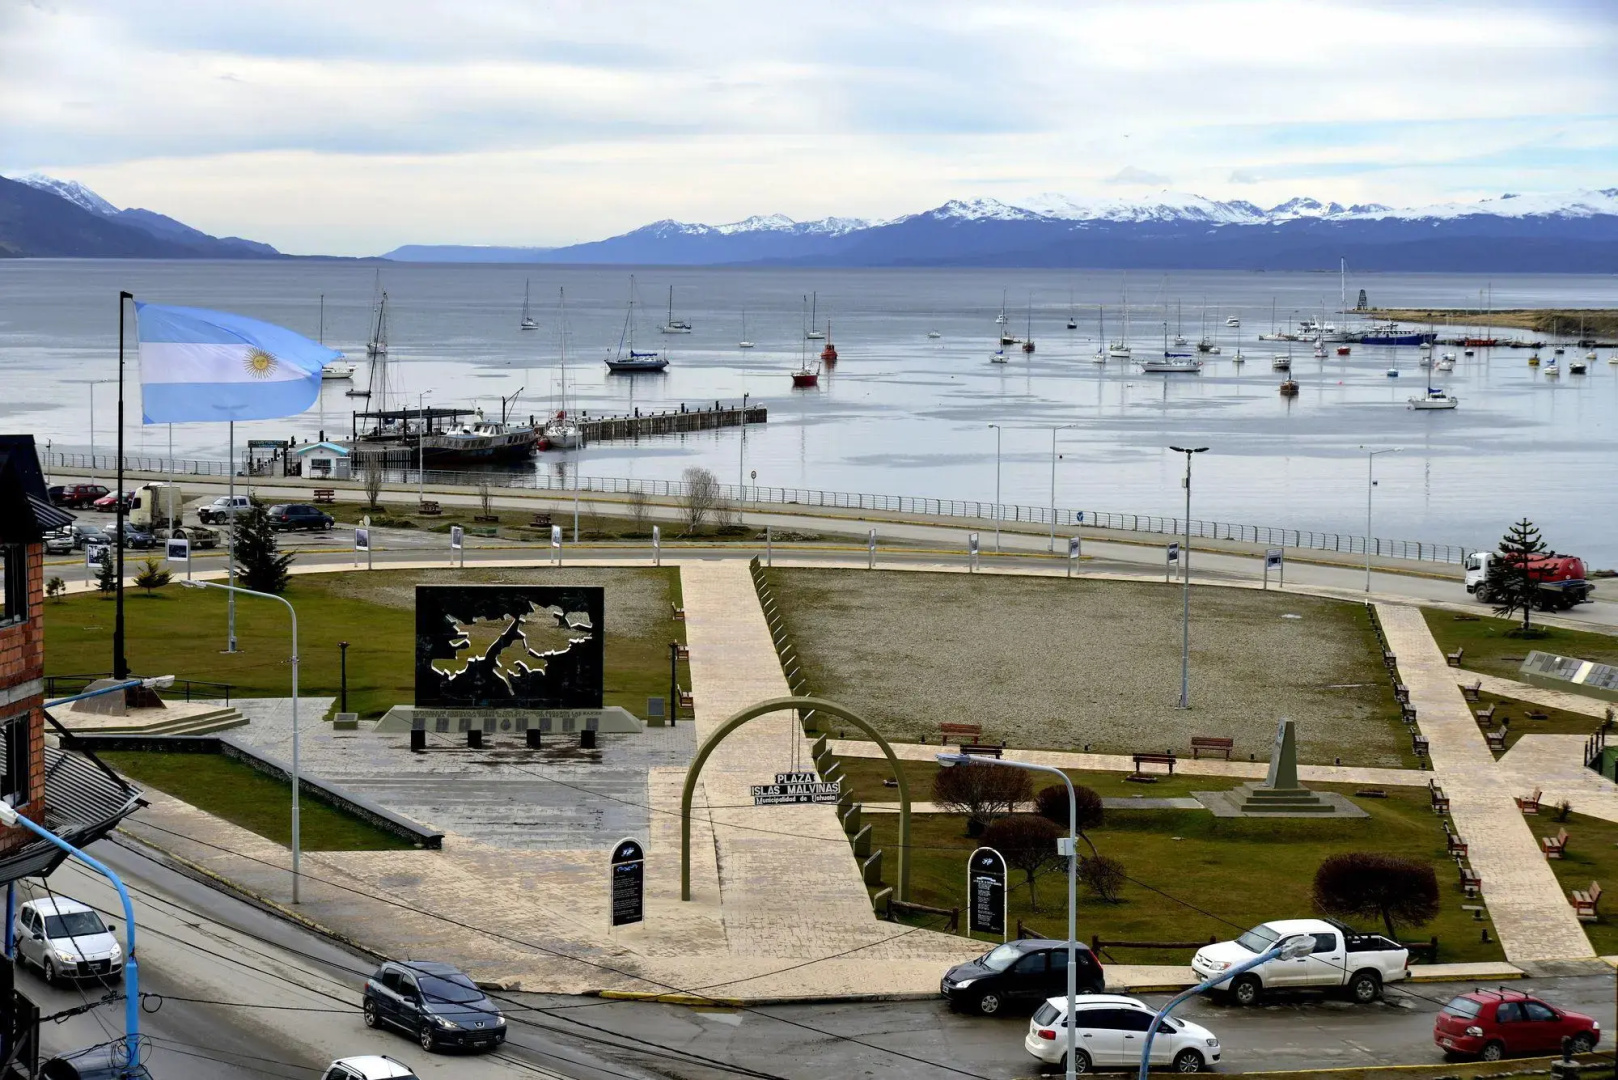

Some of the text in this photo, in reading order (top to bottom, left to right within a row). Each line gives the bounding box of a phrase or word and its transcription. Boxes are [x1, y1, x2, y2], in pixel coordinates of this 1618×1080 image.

[777, 774, 812, 784] PLAZA
[751, 783, 838, 796] ISLAS MALVINAS
